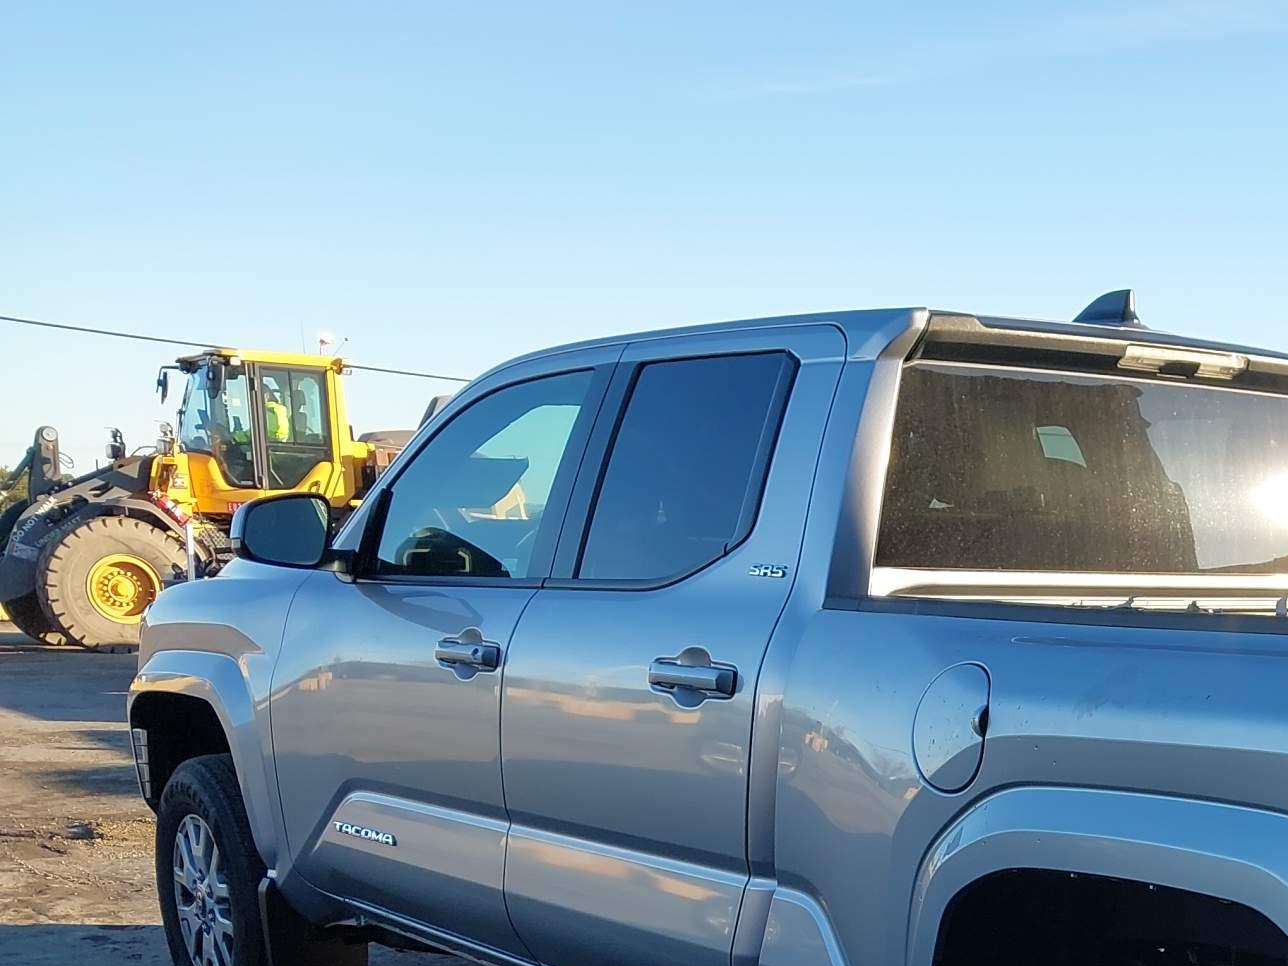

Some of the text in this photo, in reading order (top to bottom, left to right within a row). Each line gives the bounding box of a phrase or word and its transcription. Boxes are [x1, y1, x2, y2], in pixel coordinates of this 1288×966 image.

[24, 513, 39, 531] NOT
[748, 563, 787, 578] SR5
[333, 820, 397, 846] TACOMA
